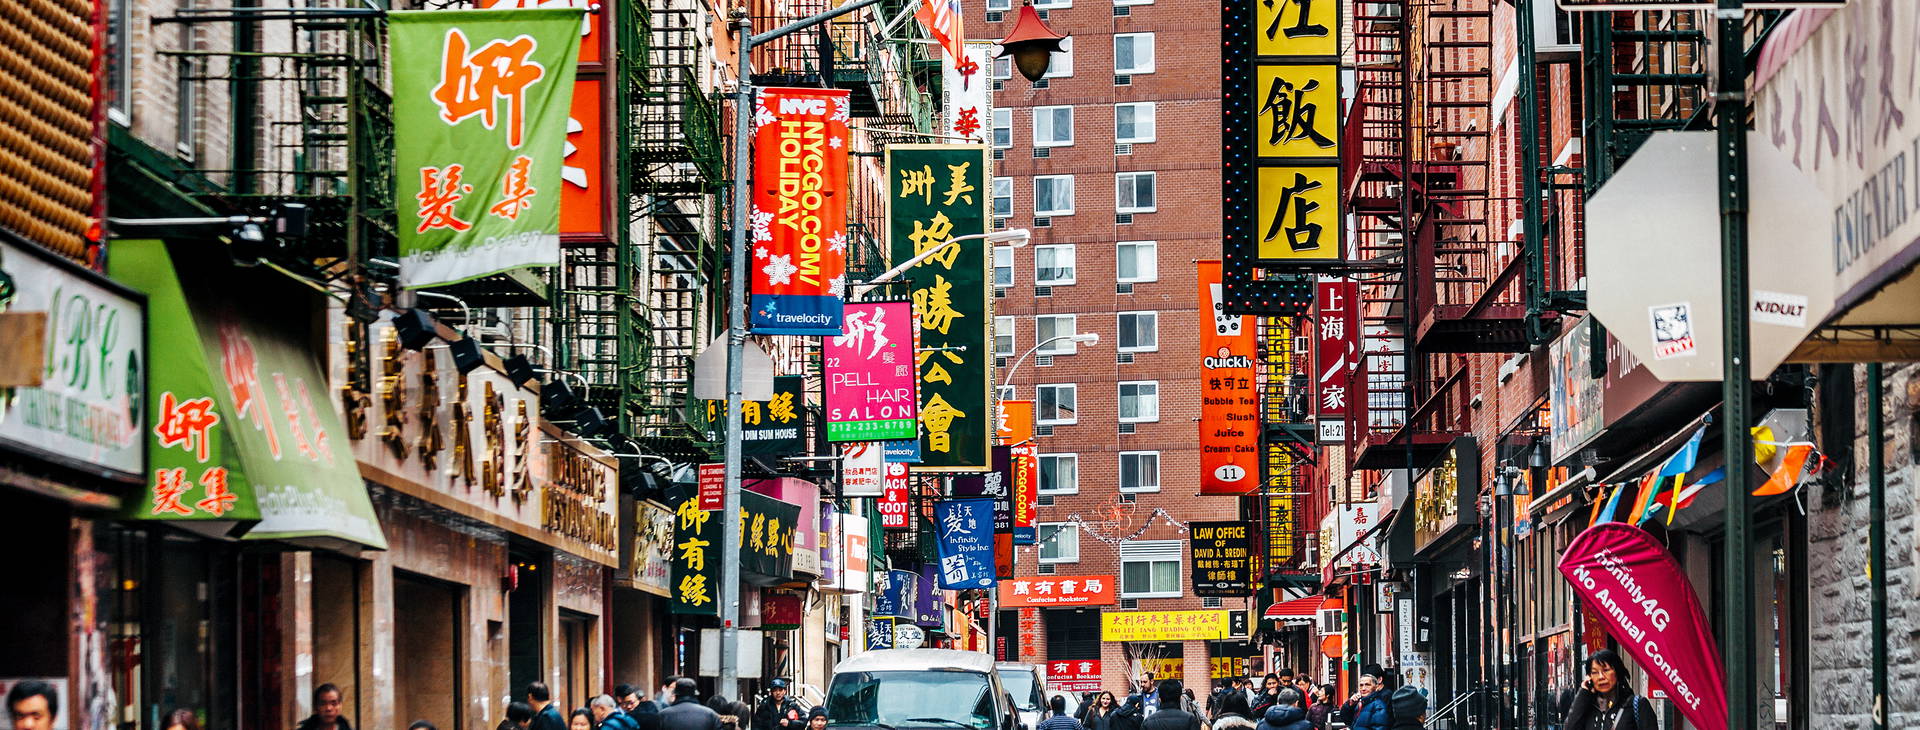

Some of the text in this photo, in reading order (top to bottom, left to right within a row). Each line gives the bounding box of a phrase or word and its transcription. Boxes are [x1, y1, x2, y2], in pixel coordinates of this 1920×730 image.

[780, 98, 826, 115] NYC
[778, 121, 801, 231] HOLIDAY
[800, 121, 824, 286] NYCGO.COM/
[1835, 151, 1908, 277] ESIGNER
[1754, 301, 1805, 316] KIDULT
[776, 313, 832, 325] travelocity
[827, 357, 840, 368] 22
[1204, 356, 1253, 369] Quickly
[832, 371, 880, 395] PELL
[1210, 377, 1249, 390] 快可立
[866, 388, 911, 403] HAIR
[1204, 397, 1254, 405] Bubble Tea
[831, 405, 911, 420] SALON
[1226, 413, 1254, 421] Slush
[745, 428, 797, 440] DIM SUM HOUSE
[1204, 445, 1254, 453] Cream Cake
[1222, 468, 1237, 479] 11
[885, 479, 907, 489] ACK
[889, 491, 897, 501] &
[878, 503, 907, 513] FOOT
[882, 515, 903, 525] RUB
[1194, 527, 1245, 539] LAW OFFICE
[677, 497, 711, 606] 佛有緣
[1194, 548, 1247, 558] DAVID A. BREDIN
[1012, 580, 1103, 595] 萬有書局
[1573, 564, 1701, 710] No Annual Contract
